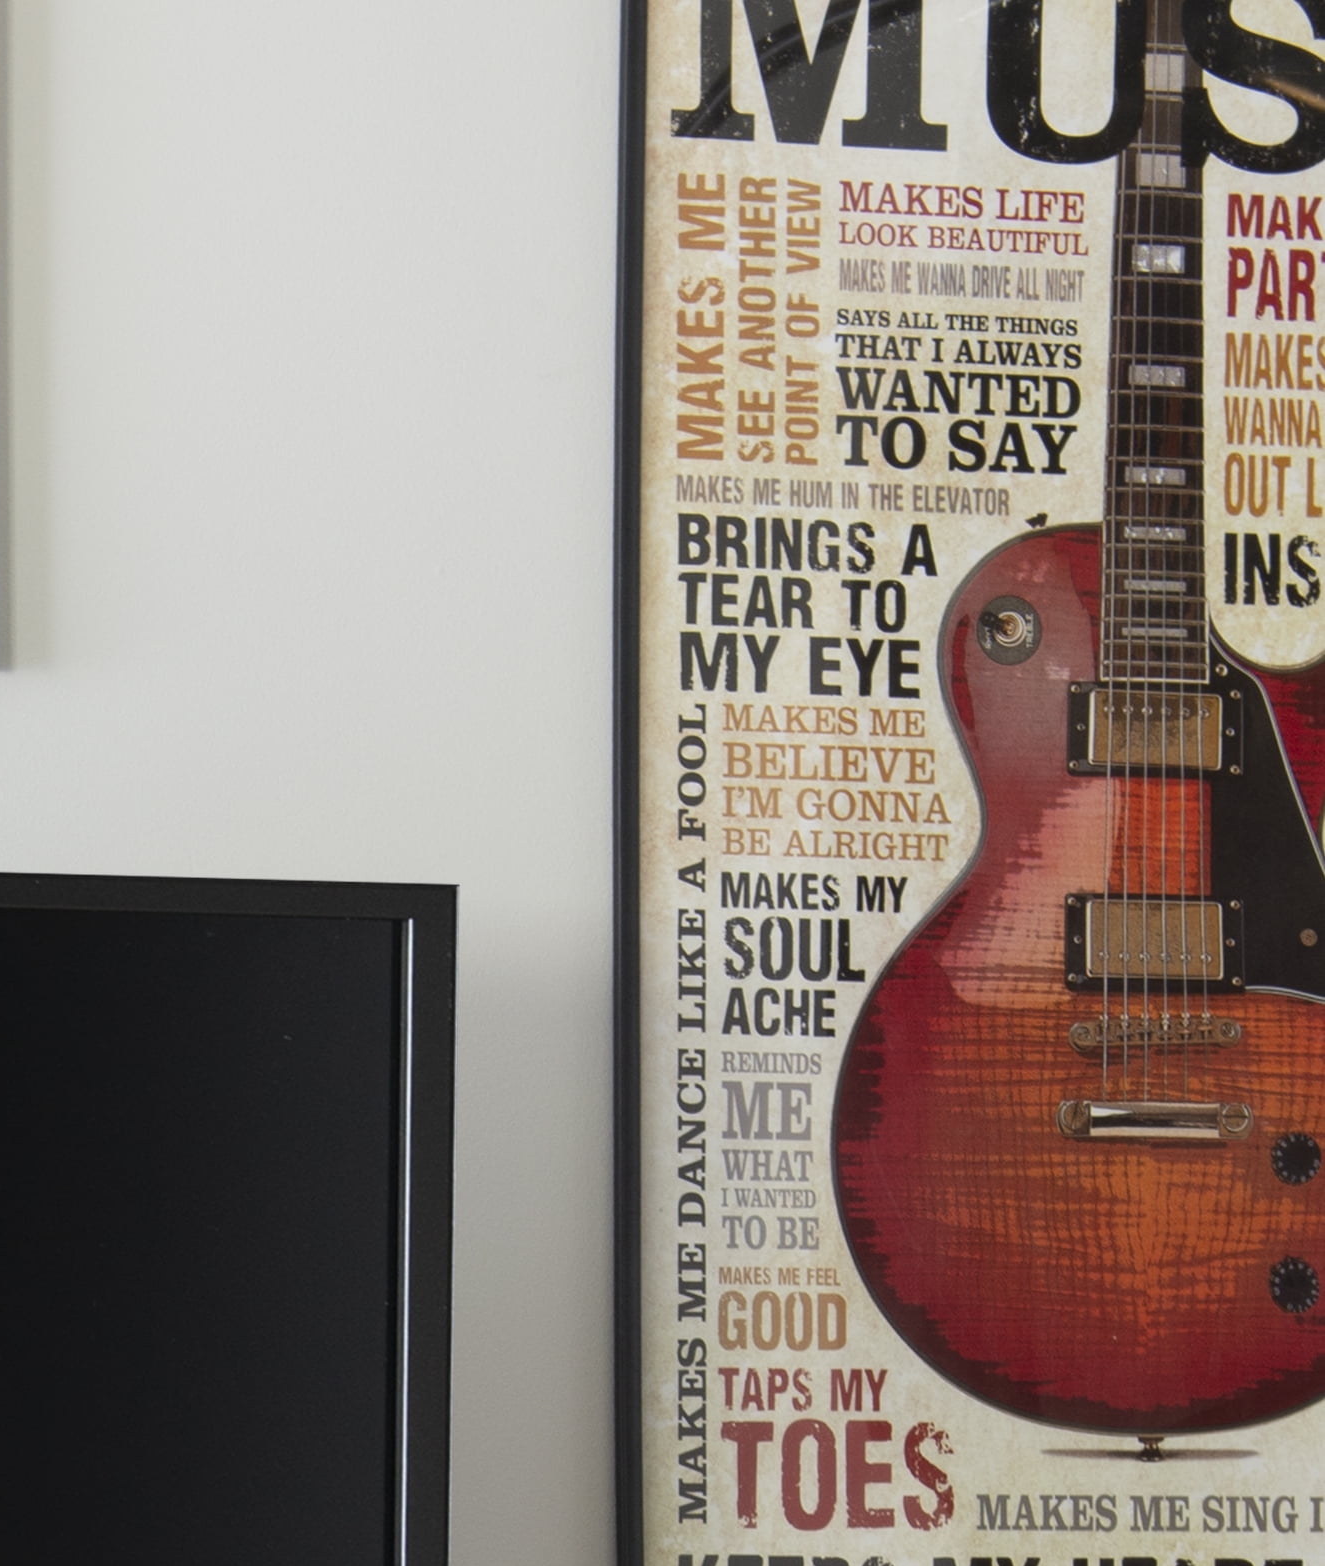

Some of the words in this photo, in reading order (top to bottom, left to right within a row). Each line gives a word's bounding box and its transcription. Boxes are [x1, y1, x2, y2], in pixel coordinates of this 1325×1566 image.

[678, 173, 725, 250] ME
[786, 179, 821, 274] VIEW
[839, 181, 983, 219] MAKES
[996, 188, 1085, 223] LIFE
[1228, 193, 1322, 240] MAK
[839, 221, 918, 247] LOOK
[929, 226, 1089, 256] BEAUTIFUL
[738, 177, 776, 370] ANOTHER
[840, 258, 886, 293] MAKES
[892, 261, 911, 294] ME
[918, 262, 966, 298] WANNA
[972, 265, 1011, 298] DRIVE
[1017, 268, 1040, 300] ALL
[1046, 268, 1085, 302] NIGHT
[786, 294, 820, 337] OF
[837, 308, 891, 327] SAYS
[897, 311, 939, 329] ALL
[945, 314, 989, 332] THE
[996, 316, 1078, 336] THINGS
[677, 277, 725, 460] MAKES
[836, 334, 922, 361] THAT
[932, 338, 944, 362] I
[954, 339, 1082, 369] ALWAYS
[785, 355, 819, 465] POINT
[837, 367, 1081, 418] WANTED
[738, 390, 775, 463] SEE
[837, 415, 927, 469] TO
[949, 419, 1077, 474] SAY
[1224, 396, 1322, 448] WANNA
[677, 474, 744, 504] MAKES
[753, 478, 781, 505] ME
[790, 480, 832, 508] HUM
[842, 481, 859, 509] IN
[869, 483, 903, 511] THE
[913, 485, 1010, 516] ELEVATOR
[1224, 452, 1291, 517] OUT
[678, 513, 875, 574] BRINGS
[901, 524, 937, 576] A
[1225, 533, 1321, 607] INS
[678, 572, 813, 628] TEAR
[842, 580, 906, 633] TO
[680, 631, 780, 692] MY
[810, 637, 920, 698] EYE
[723, 703, 858, 736] MAKES
[869, 708, 925, 738] ME
[678, 704, 706, 841] FOOL
[723, 742, 935, 784] BELIEVE
[797, 788, 951, 824] GONNA
[722, 827, 770, 855] BE
[784, 830, 949, 862] ALRIGHT
[678, 857, 706, 892] A
[721, 872, 840, 911] MAKES
[857, 876, 908, 913] MY
[678, 909, 706, 1032] LIKE
[725, 917, 866, 982] SOUL
[722, 987, 836, 1037] ACHE
[722, 1051, 821, 1075] REMINDS
[722, 1081, 811, 1140] ME
[677, 1049, 706, 1227] DANCE
[722, 1149, 813, 1181] WHAT
[721, 1187, 729, 1207] I
[734, 1188, 816, 1208] WANTED
[722, 1215, 766, 1249] TO
[777, 1217, 820, 1250] BE
[678, 1243, 706, 1322] ME
[719, 1267, 771, 1285] MAKES
[778, 1267, 800, 1285] ME
[807, 1267, 841, 1286] FEEL
[718, 1291, 847, 1351] GOOD
[718, 1367, 812, 1411] TAPS
[831, 1369, 887, 1411] MY
[677, 1338, 707, 1524] MAKES
[721, 1419, 954, 1531] TOES
[977, 1494, 1117, 1532] MAKES
[1130, 1496, 1190, 1532] ME
[1203, 1495, 1298, 1533] SING
